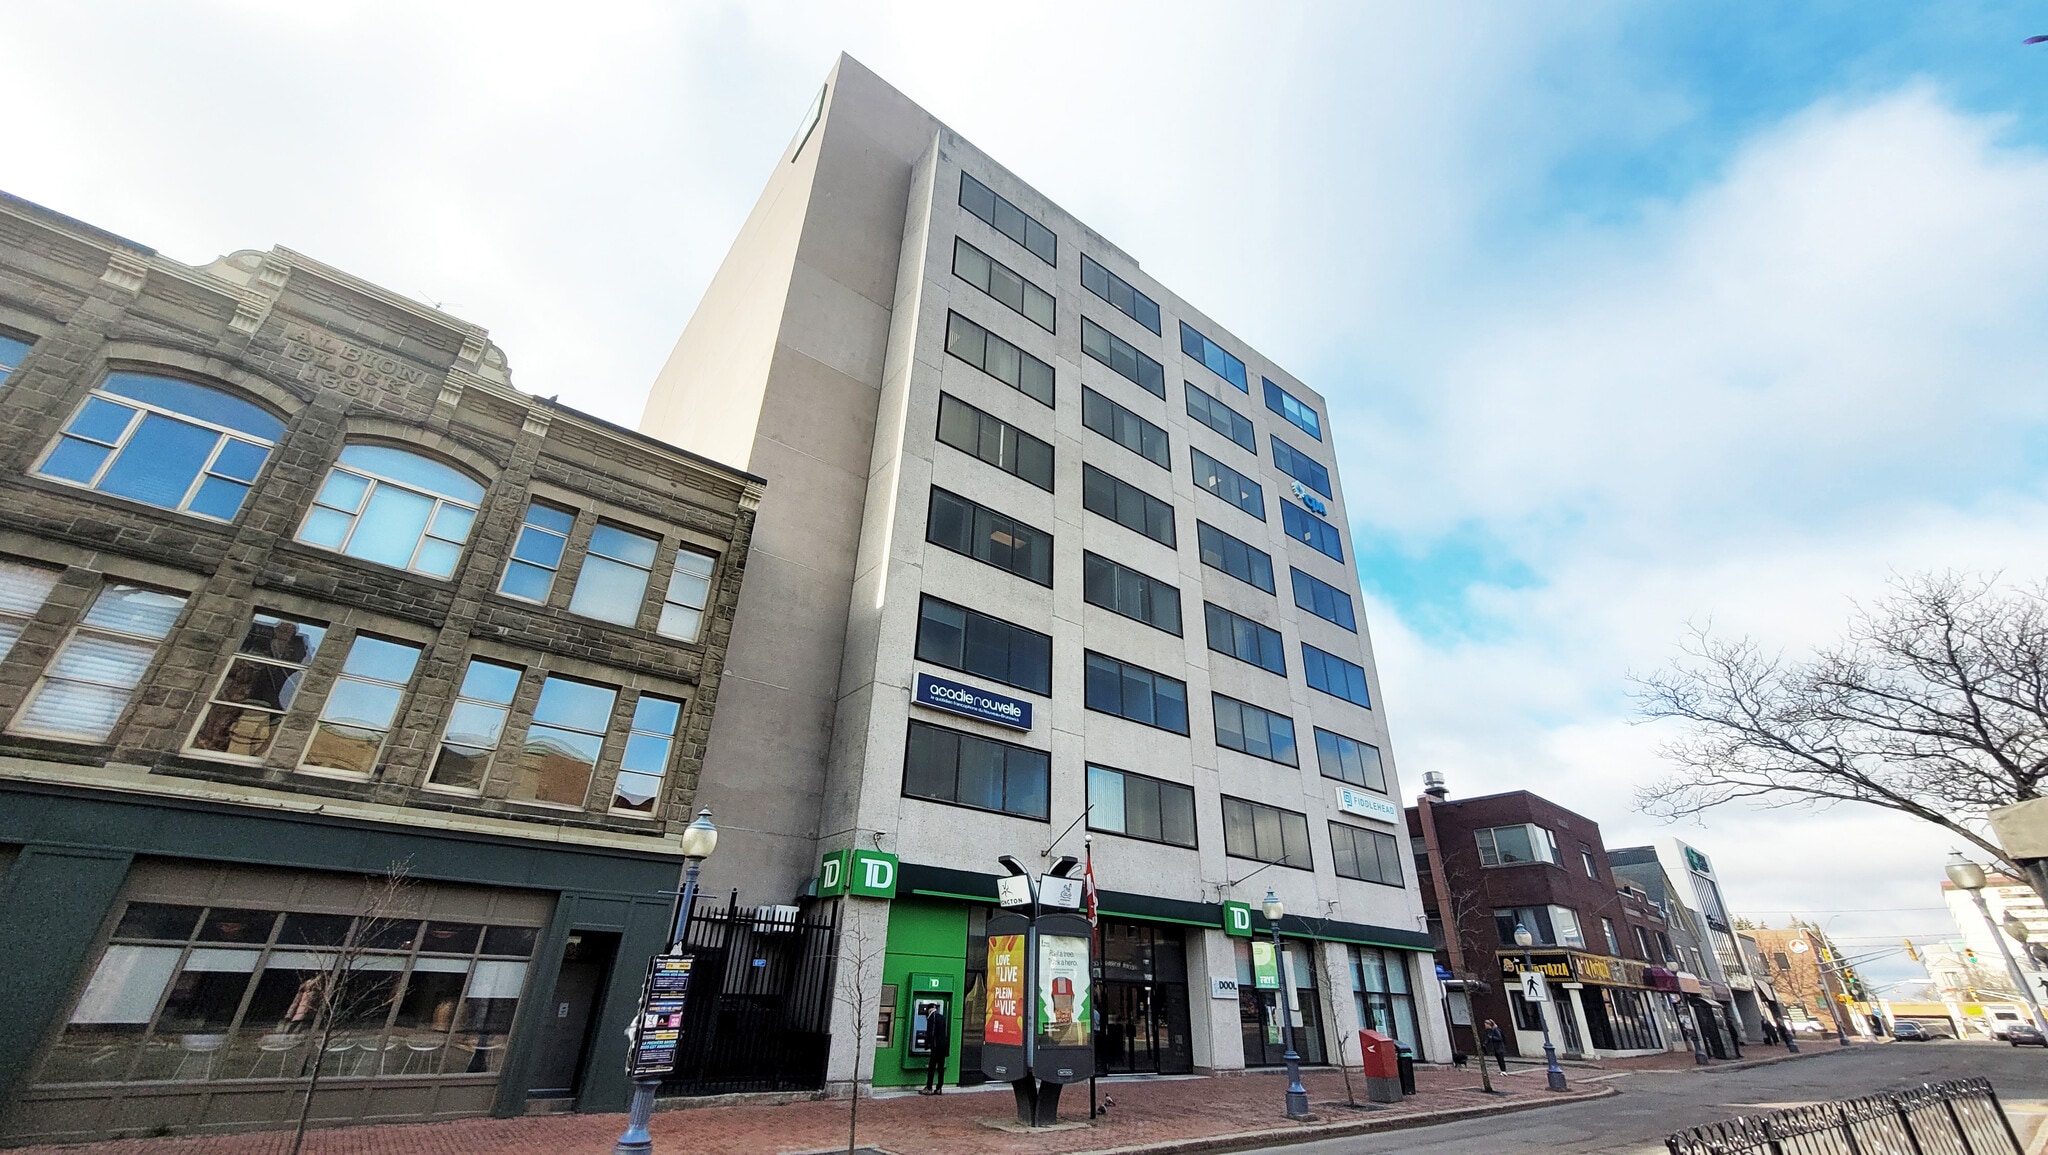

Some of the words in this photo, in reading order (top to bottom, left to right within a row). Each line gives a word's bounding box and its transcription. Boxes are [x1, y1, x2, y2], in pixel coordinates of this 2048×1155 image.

[287, 329, 422, 384] ALBION
[289, 343, 406, 396] BLOCK
[304, 367, 377, 402] 1891
[1353, 796, 1395, 815] FIDDLEHEAD
[823, 859, 840, 889] TD
[860, 858, 893, 889] TD
[1229, 907, 1250, 930] TD
[996, 954, 1011, 966] LOVE
[931, 979, 939, 987] TD
[1000, 966, 1018, 983] LIVE
[995, 987, 1013, 999] PLEIN
[1219, 981, 1237, 990] DOOL
[999, 1000, 1017, 1016] VUE
